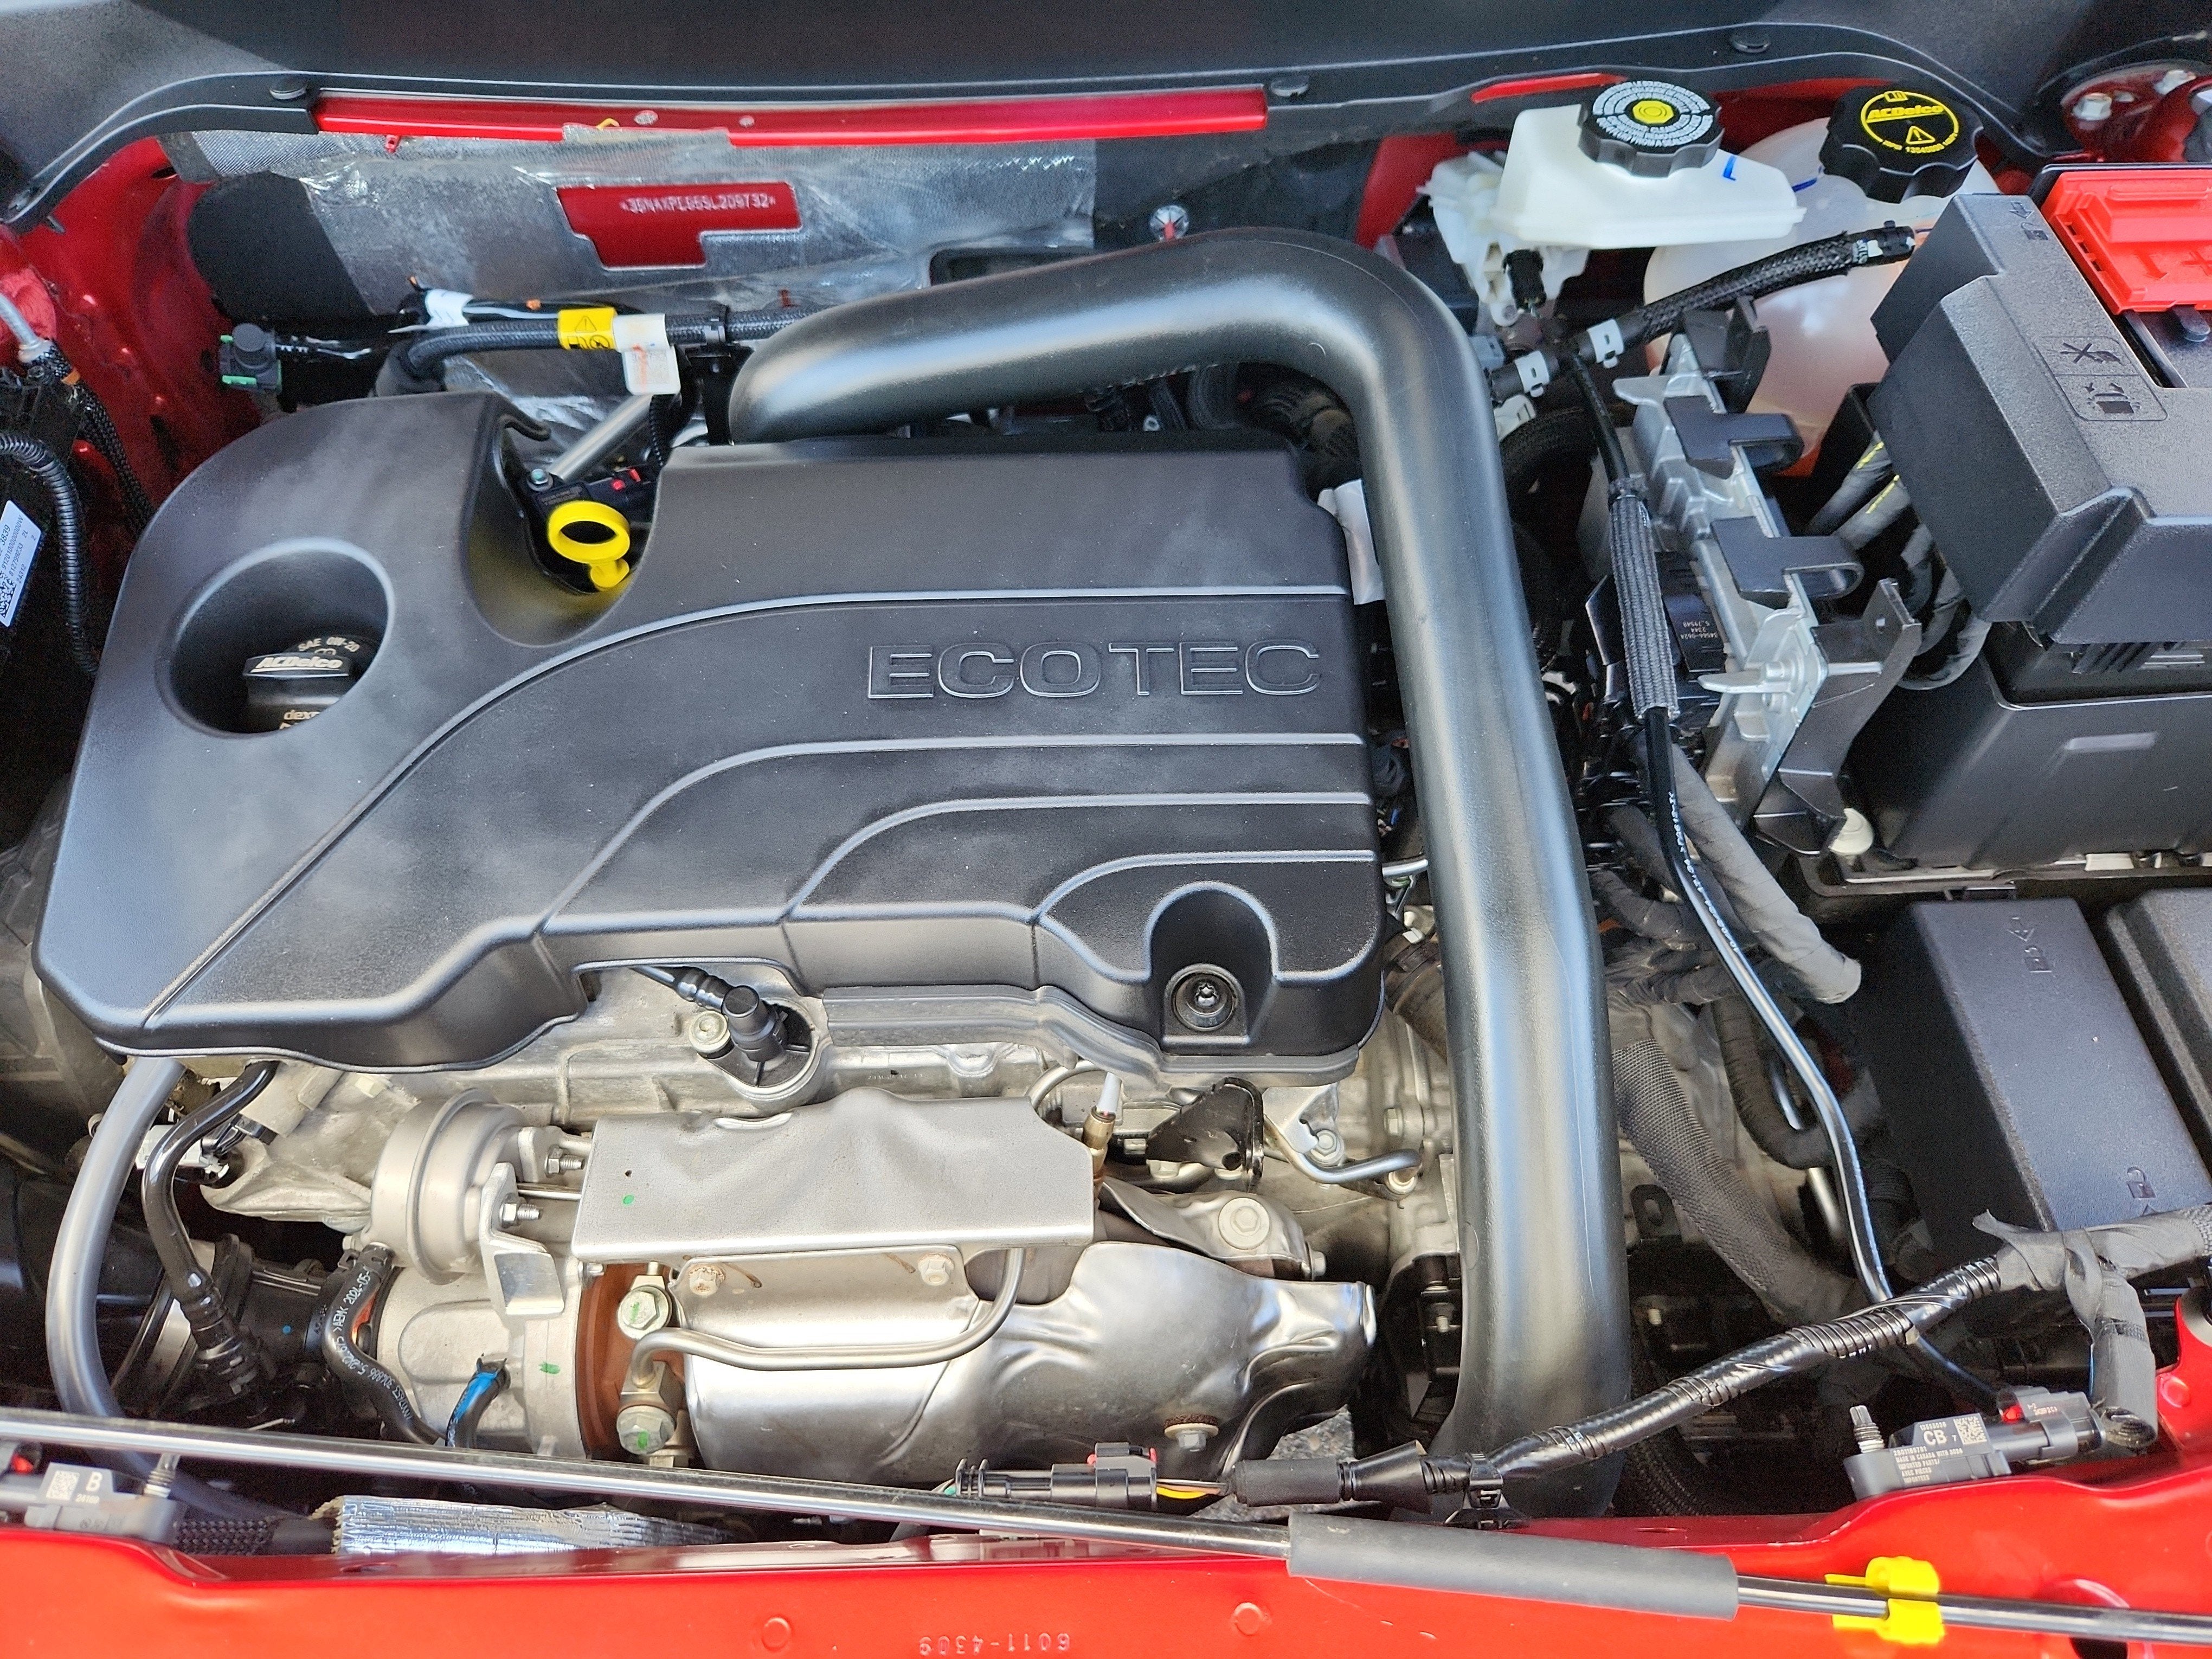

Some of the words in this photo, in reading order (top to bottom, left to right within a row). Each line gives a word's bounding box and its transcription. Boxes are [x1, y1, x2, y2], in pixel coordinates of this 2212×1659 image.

[1867, 105, 1944, 119] ACDelco
[16, 563, 26, 583] 24312
[299, 638, 321, 652] SAE
[326, 636, 361, 652] 0W-20
[255, 656, 343, 669] ACDelco
[867, 640, 1322, 698] ECOTEC
[1924, 1429, 1947, 1445] CB
[1916, 1451, 1936, 1460] CANADA
[85, 1471, 102, 1492] B
[919, 1633, 1070, 1656] 6011-4309
